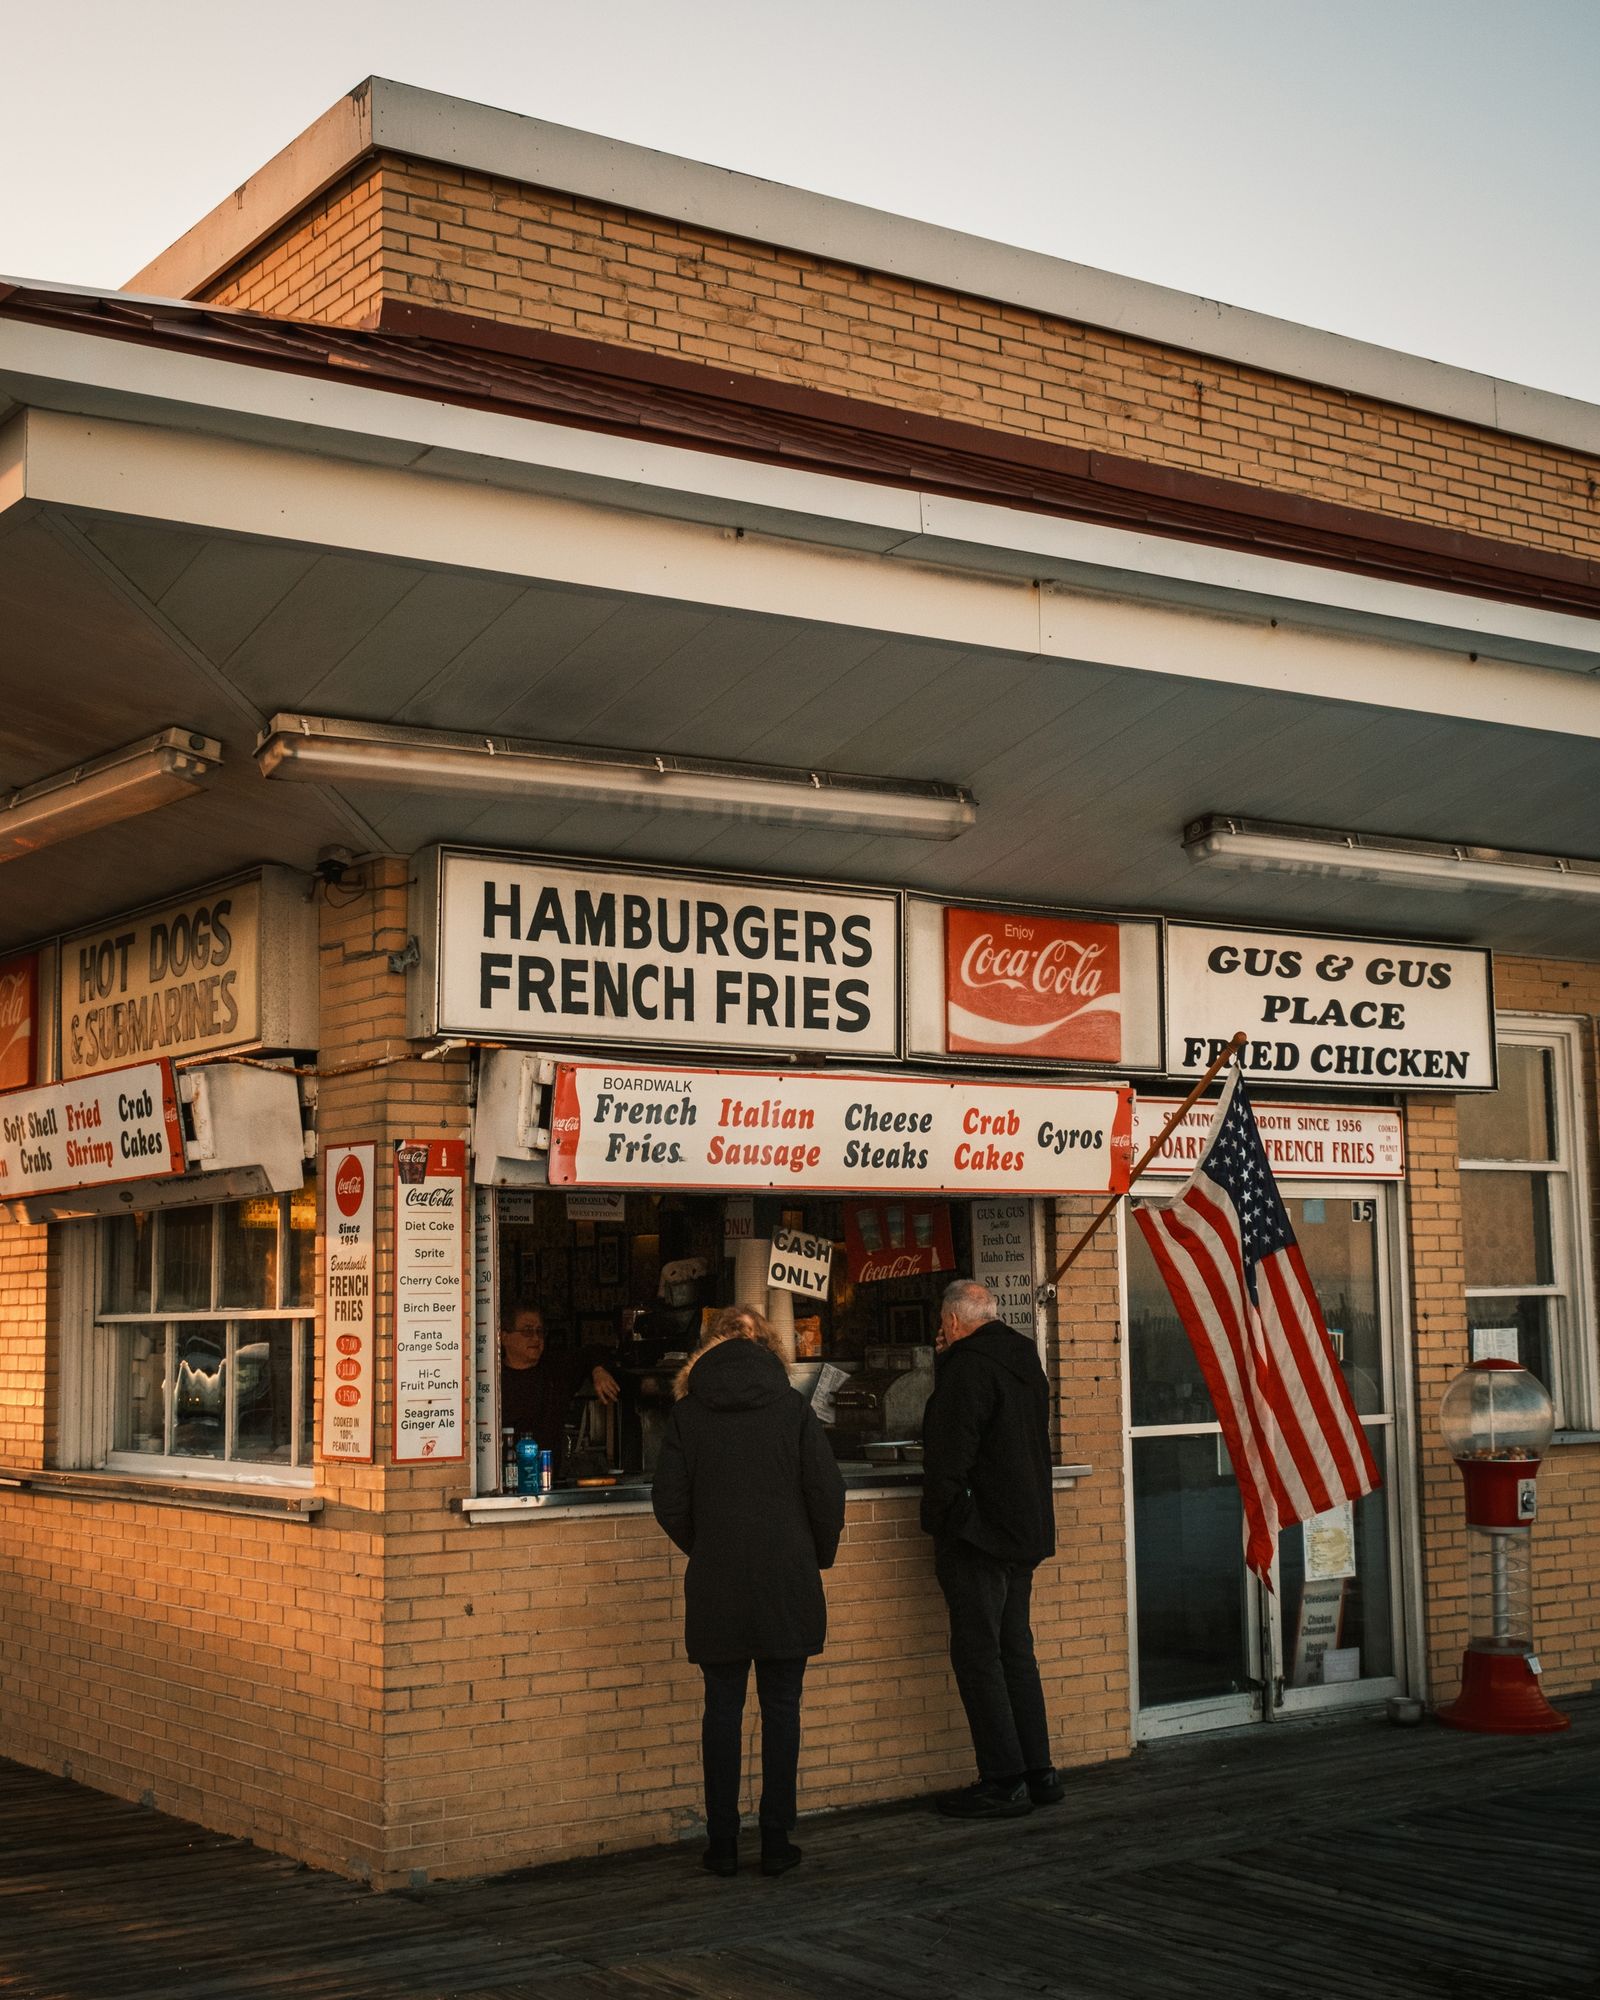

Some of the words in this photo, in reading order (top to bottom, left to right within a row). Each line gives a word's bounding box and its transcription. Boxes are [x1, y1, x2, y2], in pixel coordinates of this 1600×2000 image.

[483, 881, 873, 968] HAMBURGERS
[1004, 923, 1035, 942] Enjoy
[79, 933, 136, 1004] HOT
[150, 900, 232, 983] DOGS
[961, 933, 1107, 997] Coca-Cola
[1207, 944, 1302, 980] GUS
[1316, 953, 1354, 982] &
[1365, 957, 1452, 990] GUS
[480, 952, 695, 1022] FRENCH
[715, 970, 871, 1033] FRIES
[86, 970, 238, 1067] SUBMARINES
[1261, 995, 1405, 1030] PLACE
[1310, 1043, 1470, 1079] CHICKEN
[603, 1077, 692, 1093] BOARDWALK
[66, 1100, 102, 1132] Fried
[118, 1089, 153, 1121] Crab
[593, 1093, 697, 1126] French
[717, 1098, 815, 1129] Italian
[3, 1114, 26, 1147] Soft
[28, 1108, 58, 1139] Shell
[844, 1103, 932, 1133] Cheese
[962, 1107, 1020, 1136] Crab
[1297, 1117, 1330, 1132] SINCE
[1336, 1119, 1362, 1133] 1956
[120, 1129, 163, 1159] Cakes
[605, 1133, 681, 1163] Fries
[1037, 1121, 1103, 1155] Gyros
[20, 1146, 53, 1174] Crabs
[66, 1137, 114, 1169] Shrimp
[706, 1135, 821, 1172] Sausage
[843, 1140, 928, 1169] Steaks
[954, 1143, 1025, 1171] Cakes
[1265, 1139, 1324, 1163] FRENCH
[1332, 1142, 1375, 1165] FRIES
[405, 1187, 454, 1207] Coca-Cola
[977, 1208, 995, 1220] GUS
[997, 1208, 1005, 1219] &
[1006, 1206, 1024, 1218] GUS
[338, 1223, 360, 1235] Since
[405, 1221, 426, 1231] Diet
[429, 1221, 454, 1231] Coke
[724, 1216, 751, 1236] ONLY
[340, 1234, 359, 1246] 1956
[773, 1231, 831, 1264] CASH
[982, 1234, 1005, 1246] Fresh
[1006, 1233, 1021, 1245] Cut
[330, 1254, 367, 1272] Boardwalk
[415, 1248, 445, 1259] Sprite
[981, 1251, 1003, 1263] Idaho
[1005, 1250, 1024, 1262] Fries
[329, 1274, 369, 1297] FRENCH
[400, 1275, 432, 1287] Cherry
[435, 1275, 459, 1285] Coke
[770, 1262, 827, 1292] ONLY
[985, 1276, 999, 1288] SM
[334, 1299, 363, 1322] FRIES
[403, 1303, 430, 1313] Birch
[433, 1302, 456, 1312] Beer
[398, 1342, 432, 1352] Orange
[435, 1341, 459, 1351] Soda
[414, 1330, 442, 1340] Fanta
[400, 1381, 424, 1391] Fruit
[427, 1380, 459, 1390] Punch
[419, 1368, 441, 1379] Hi-C
[333, 1416, 353, 1428] COOKED
[354, 1416, 360, 1427] IN
[401, 1420, 435, 1431] Ginger
[438, 1419, 455, 1428] Ale
[404, 1408, 455, 1419] Seagrams
[332, 1441, 351, 1453] PEANUT
[352, 1441, 360, 1453] OIL
